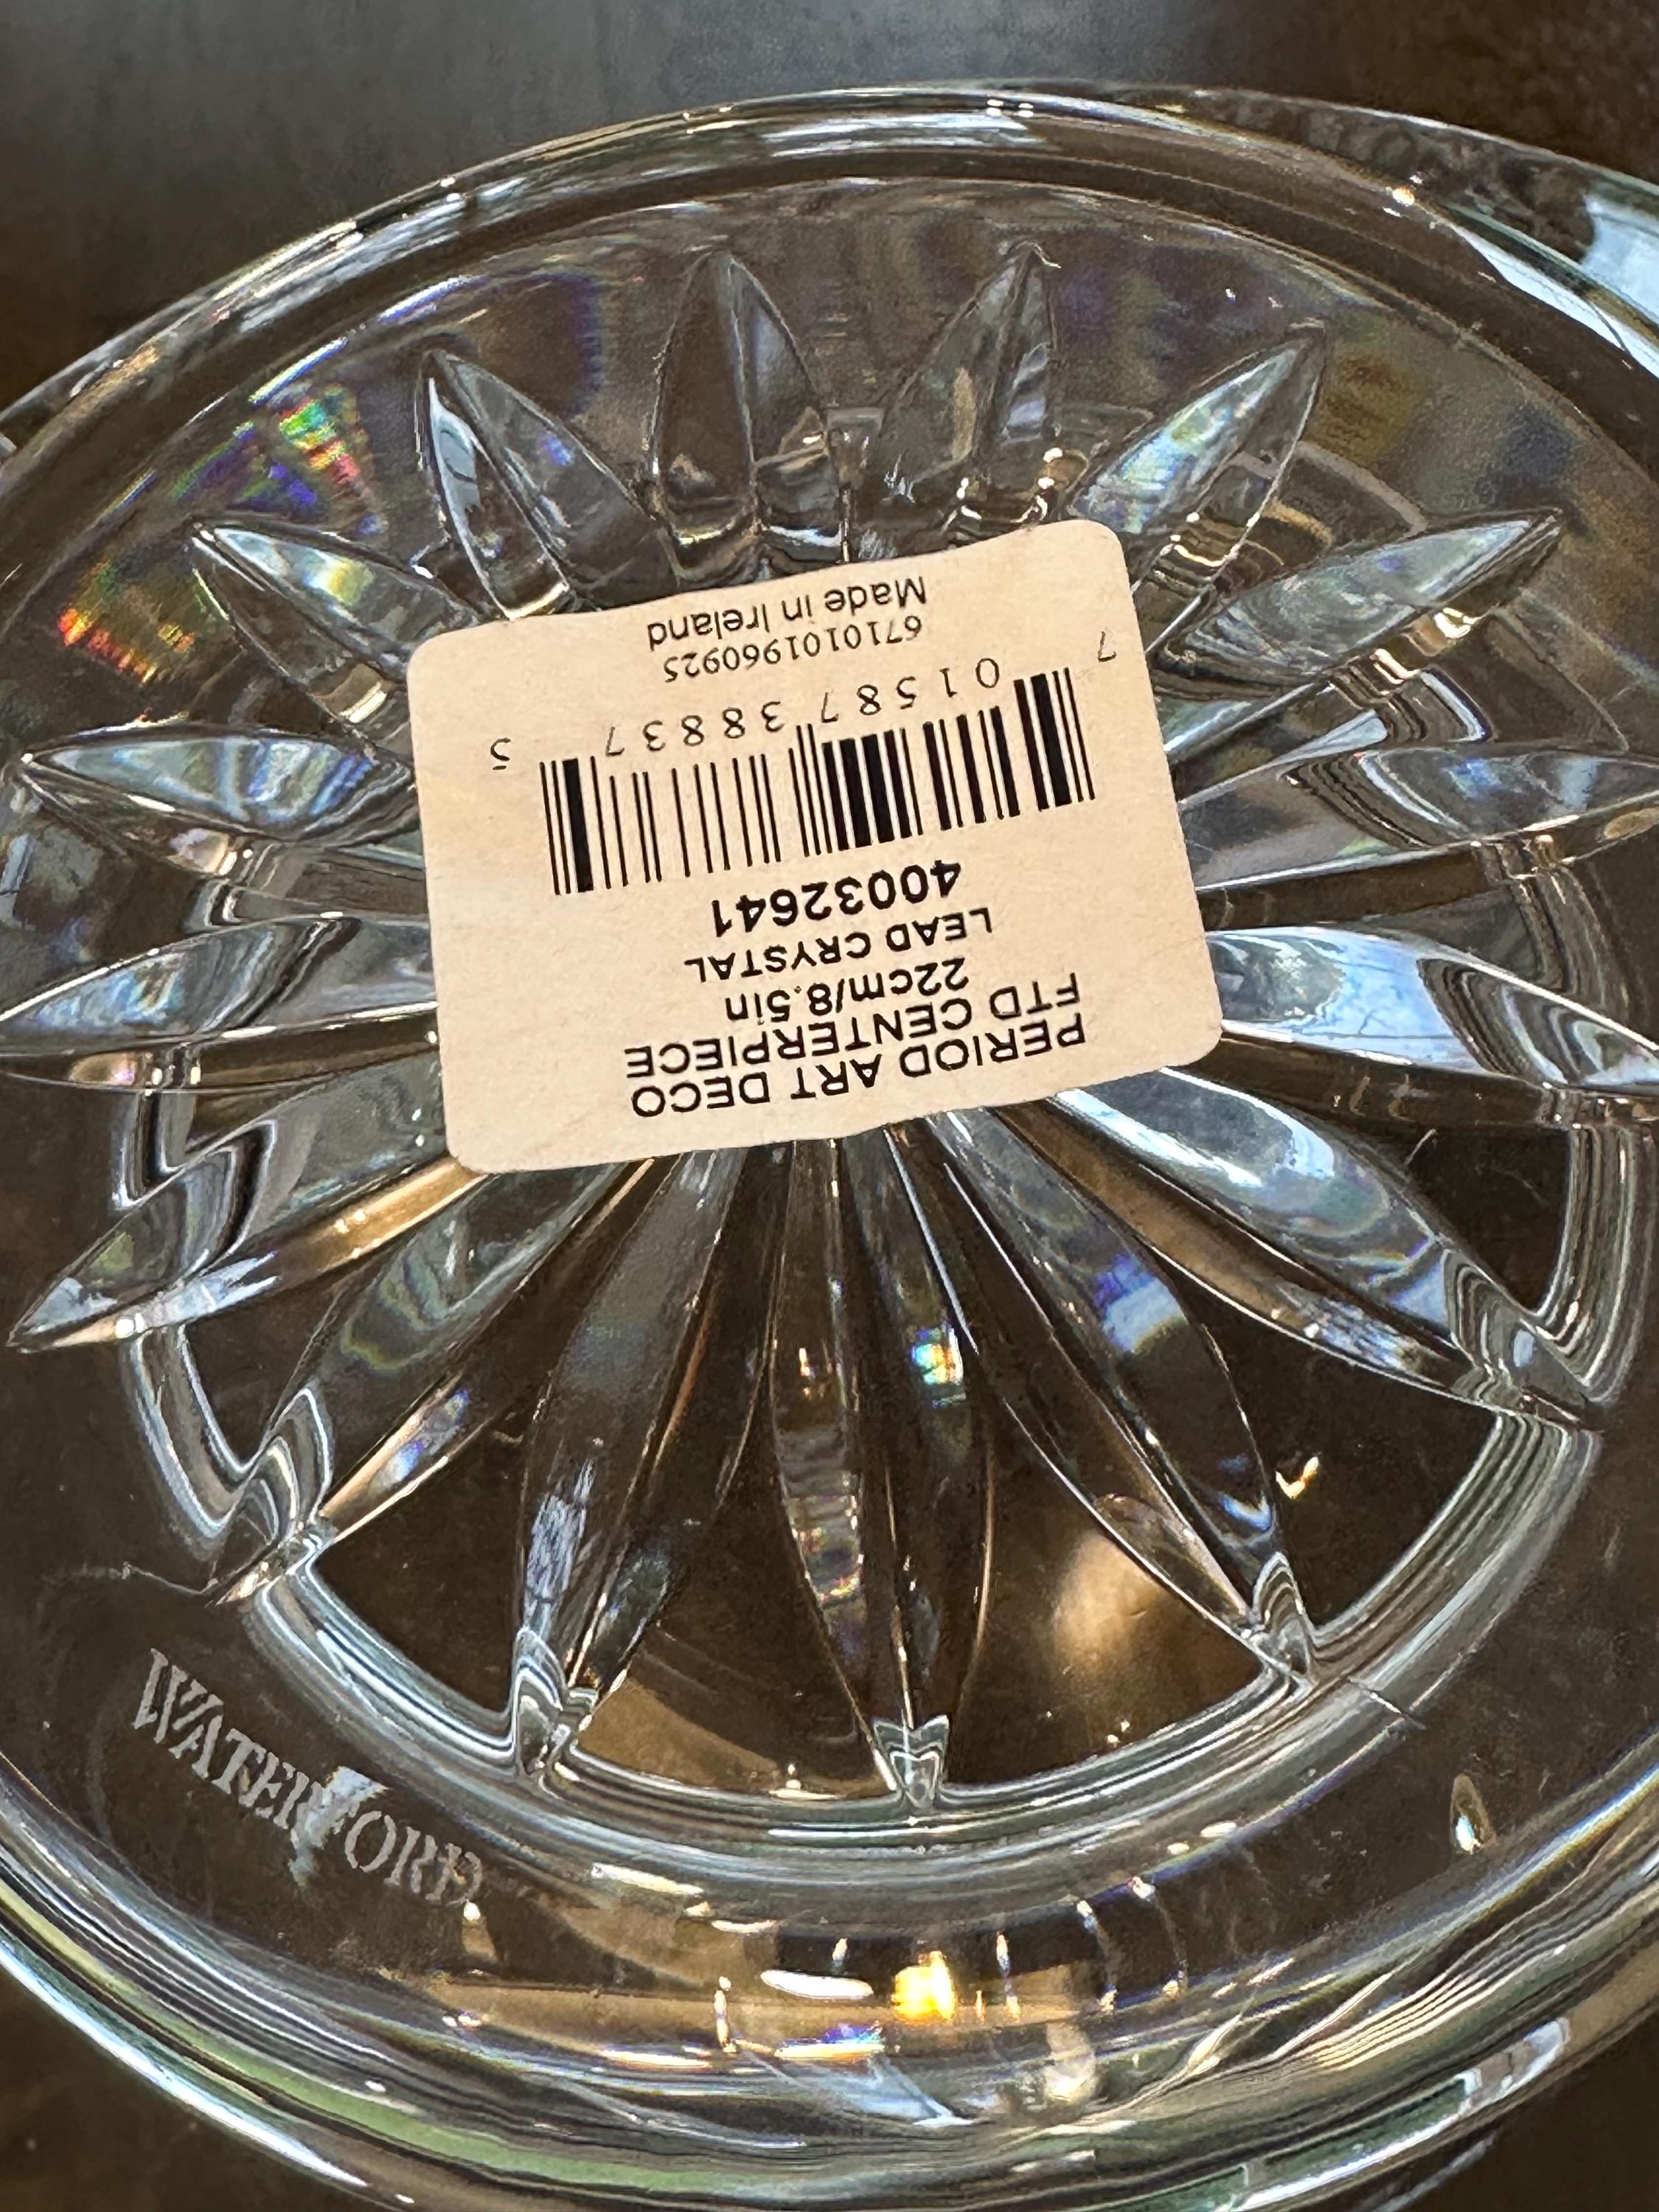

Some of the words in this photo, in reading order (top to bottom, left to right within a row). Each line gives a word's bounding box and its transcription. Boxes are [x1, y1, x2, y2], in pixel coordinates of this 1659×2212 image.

[782, 594, 813, 623] in
[824, 576, 927, 615] Made
[647, 603, 770, 652] Ireland
[664, 615, 922, 683] 6710101960925
[712, 860, 961, 938] 40032641
[884, 907, 992, 953] LEAD
[684, 931, 872, 983] CRYSTAL
[724, 957, 970, 1026] 22cm/8.5in
[989, 972, 1080, 1020] FTD
[624, 998, 973, 1079] CENTERPIECE
[898, 1012, 1086, 1078] PERIOD
[630, 1071, 771, 1118] DECO
[790, 1053, 883, 1101] ART
